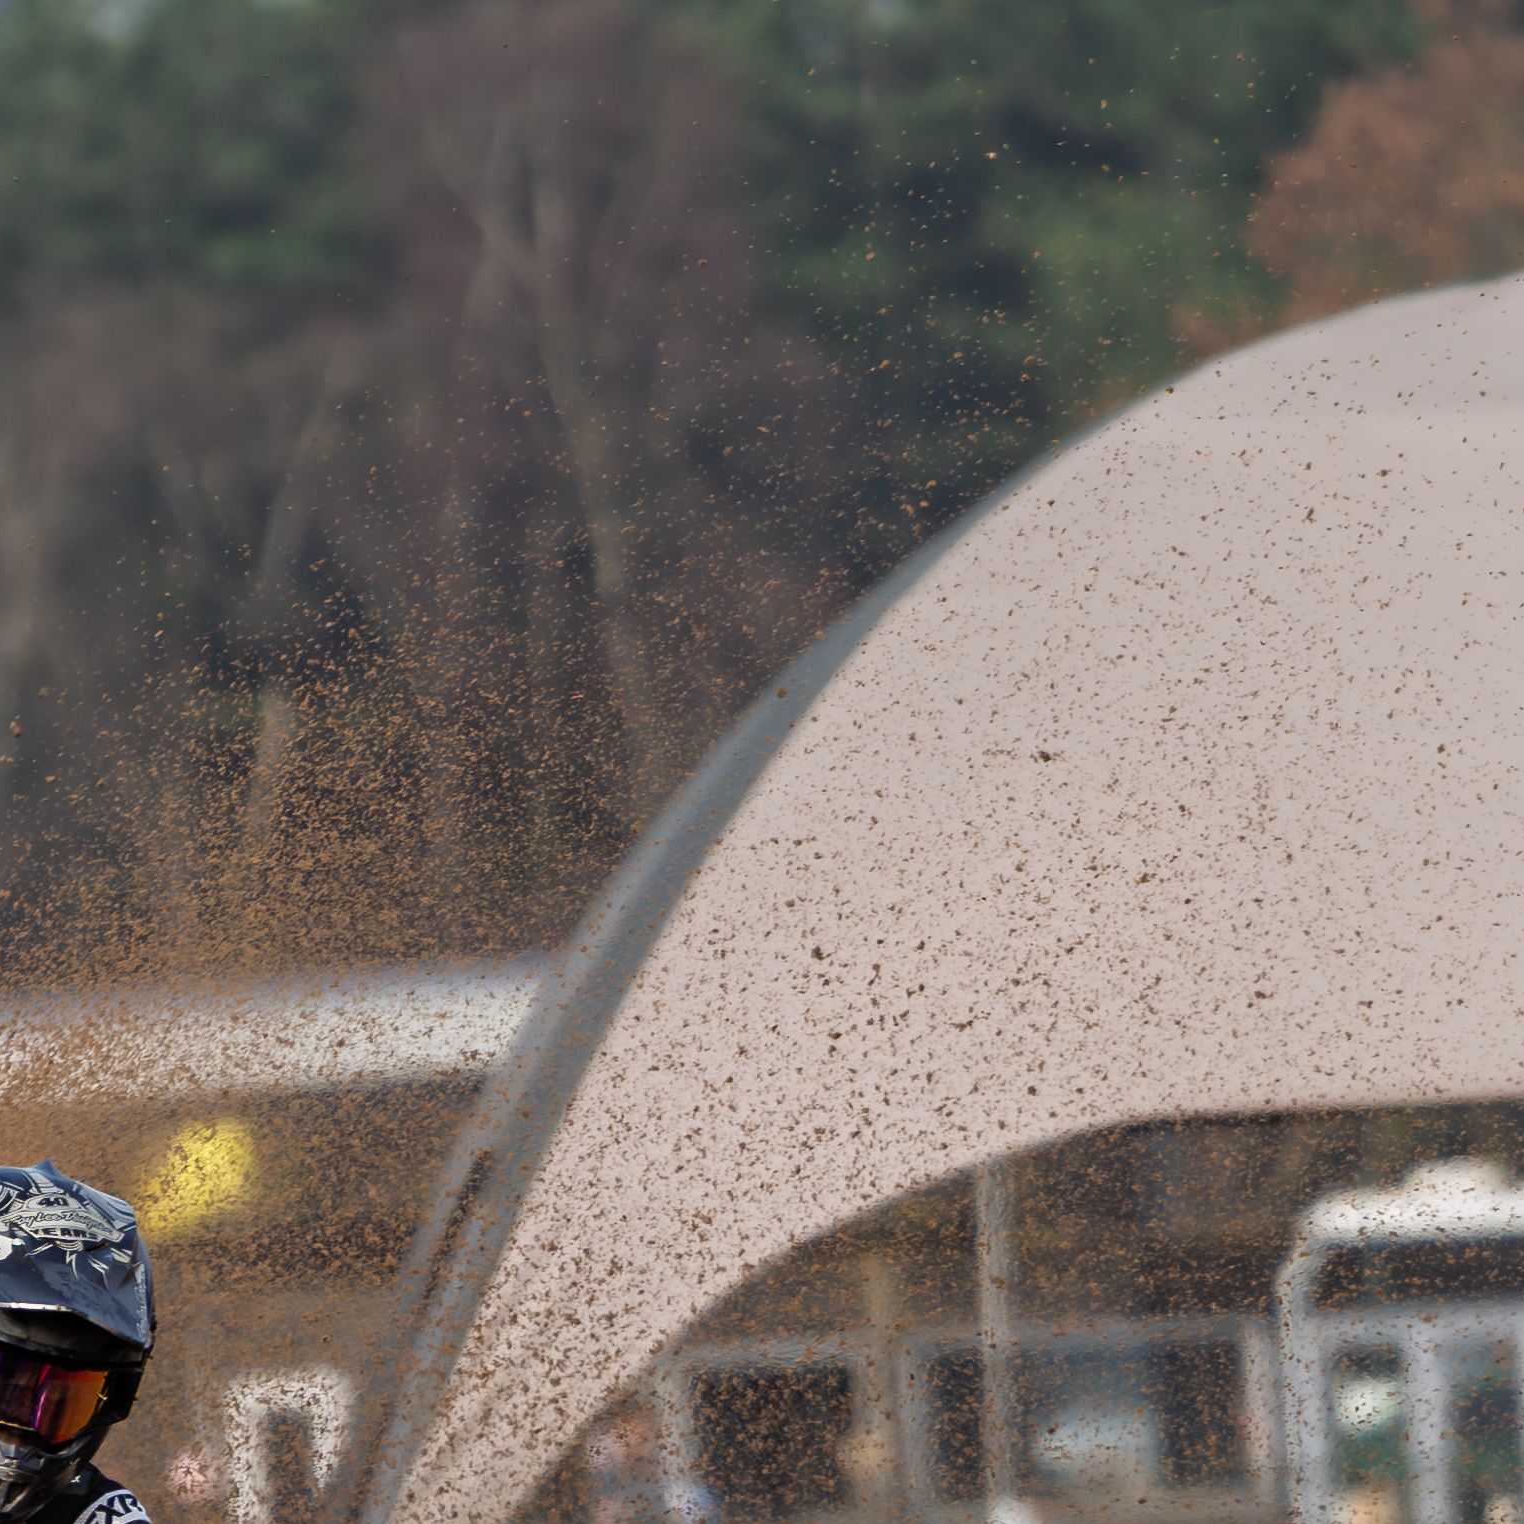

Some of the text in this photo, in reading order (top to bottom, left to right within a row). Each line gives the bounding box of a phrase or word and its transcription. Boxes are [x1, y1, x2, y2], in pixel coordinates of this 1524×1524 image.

[37, 1194, 70, 1208] 40
[35, 1211, 61, 1224] Lee
[33, 1226, 100, 1241] YEARS
